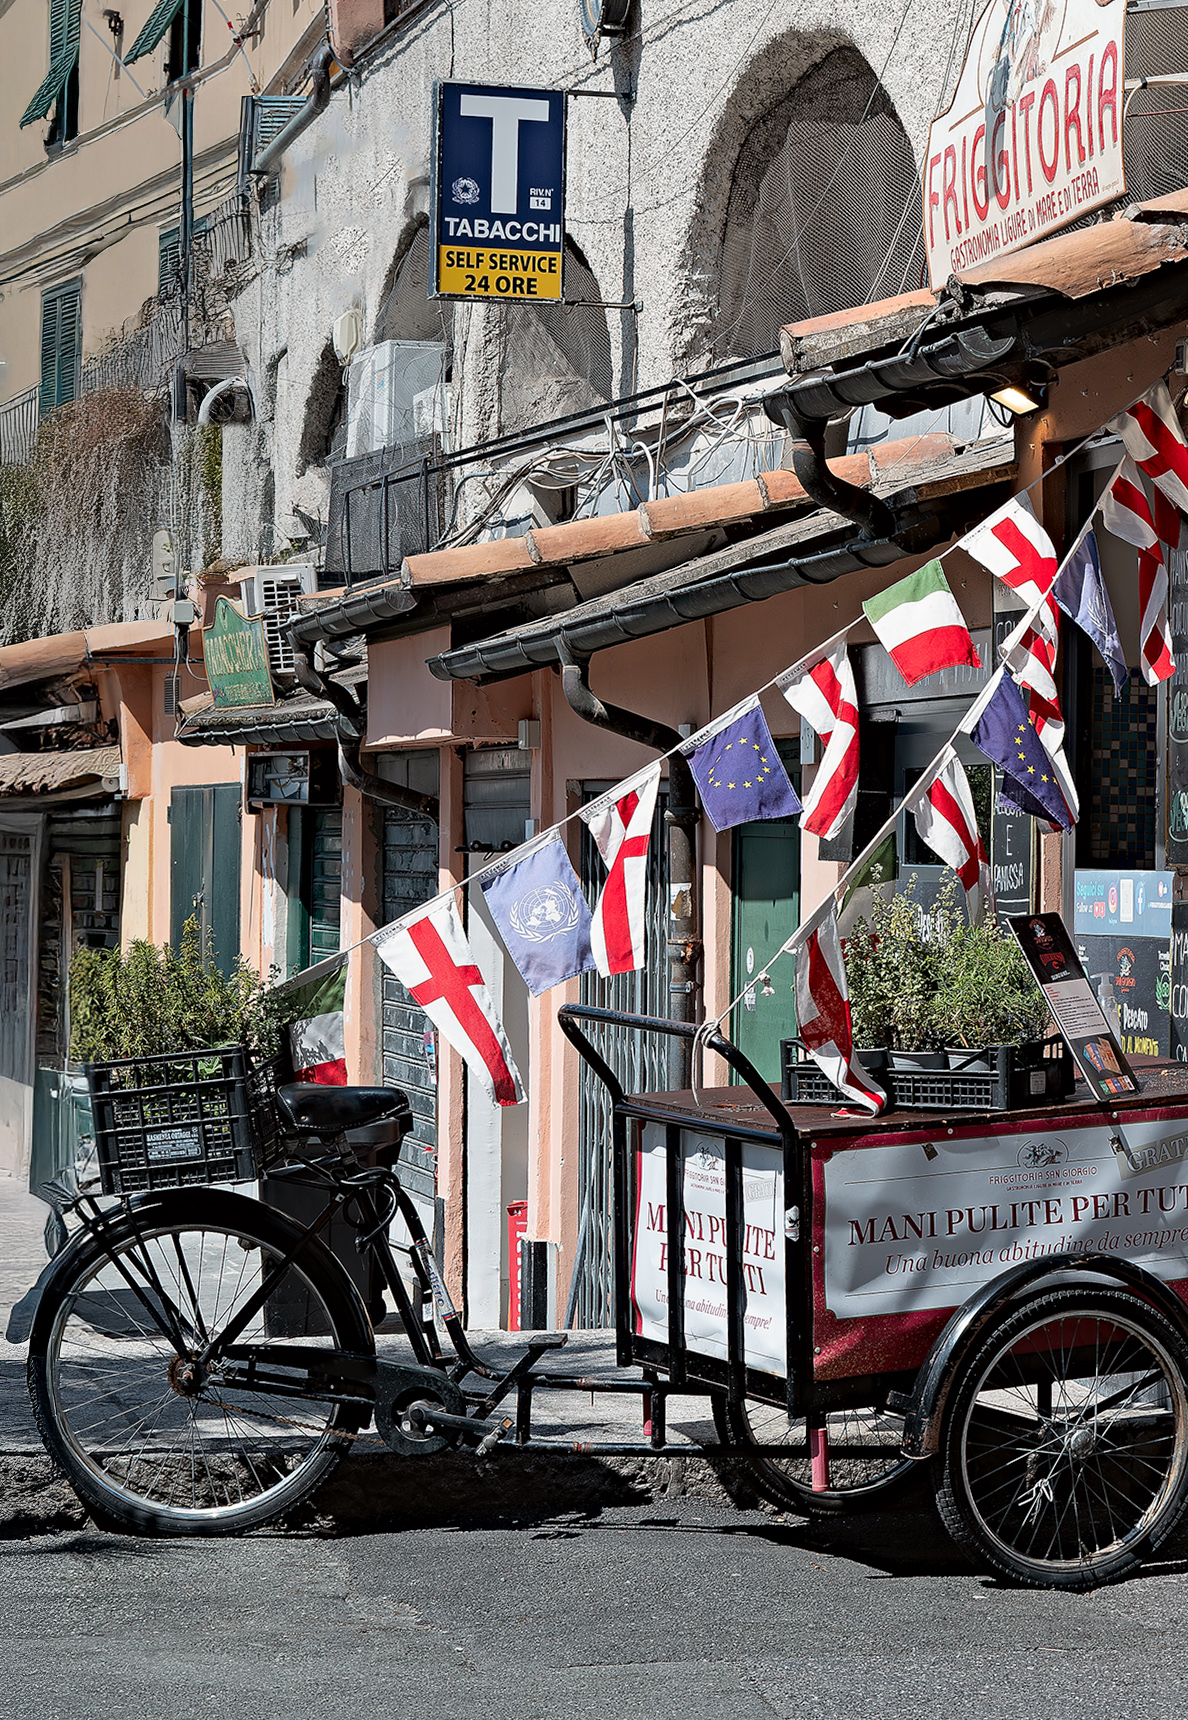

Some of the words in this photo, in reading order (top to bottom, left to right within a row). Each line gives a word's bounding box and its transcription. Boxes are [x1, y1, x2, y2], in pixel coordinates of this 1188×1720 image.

[460, 94, 549, 215] T
[928, 40, 1118, 250] FRIGGITORIA
[445, 217, 561, 243] TABACCHI
[950, 223, 1000, 273] GASTRONOMIA
[1001, 208, 1028, 246] LIGURE
[1027, 212, 1036, 232] DI
[1036, 190, 1058, 228] MARE
[1058, 194, 1065, 215] E
[1063, 184, 1073, 210] DI
[1071, 166, 1100, 205] TERRA
[446, 250, 485, 269] SELF
[489, 253, 557, 274] SERVICE
[464, 274, 490, 293] 24
[496, 276, 538, 296] ORE
[1076, 882, 1097, 898] Seguici
[989, 1171, 1043, 1185] FRIGGITORIA
[1045, 1169, 1060, 1180] SAN
[1062, 1166, 1098, 1179] GIORGIO
[647, 1201, 705, 1240] MNI
[709, 1214, 776, 1261] PUITE
[847, 1211, 938, 1246] MANI
[945, 1198, 1064, 1236] PULITE
[1069, 1191, 1130, 1224] PER
[884, 1253, 928, 1275] Una
[932, 1247, 994, 1271] buona
[998, 1233, 1095, 1264] abitudine
[1098, 1230, 1121, 1252] da
